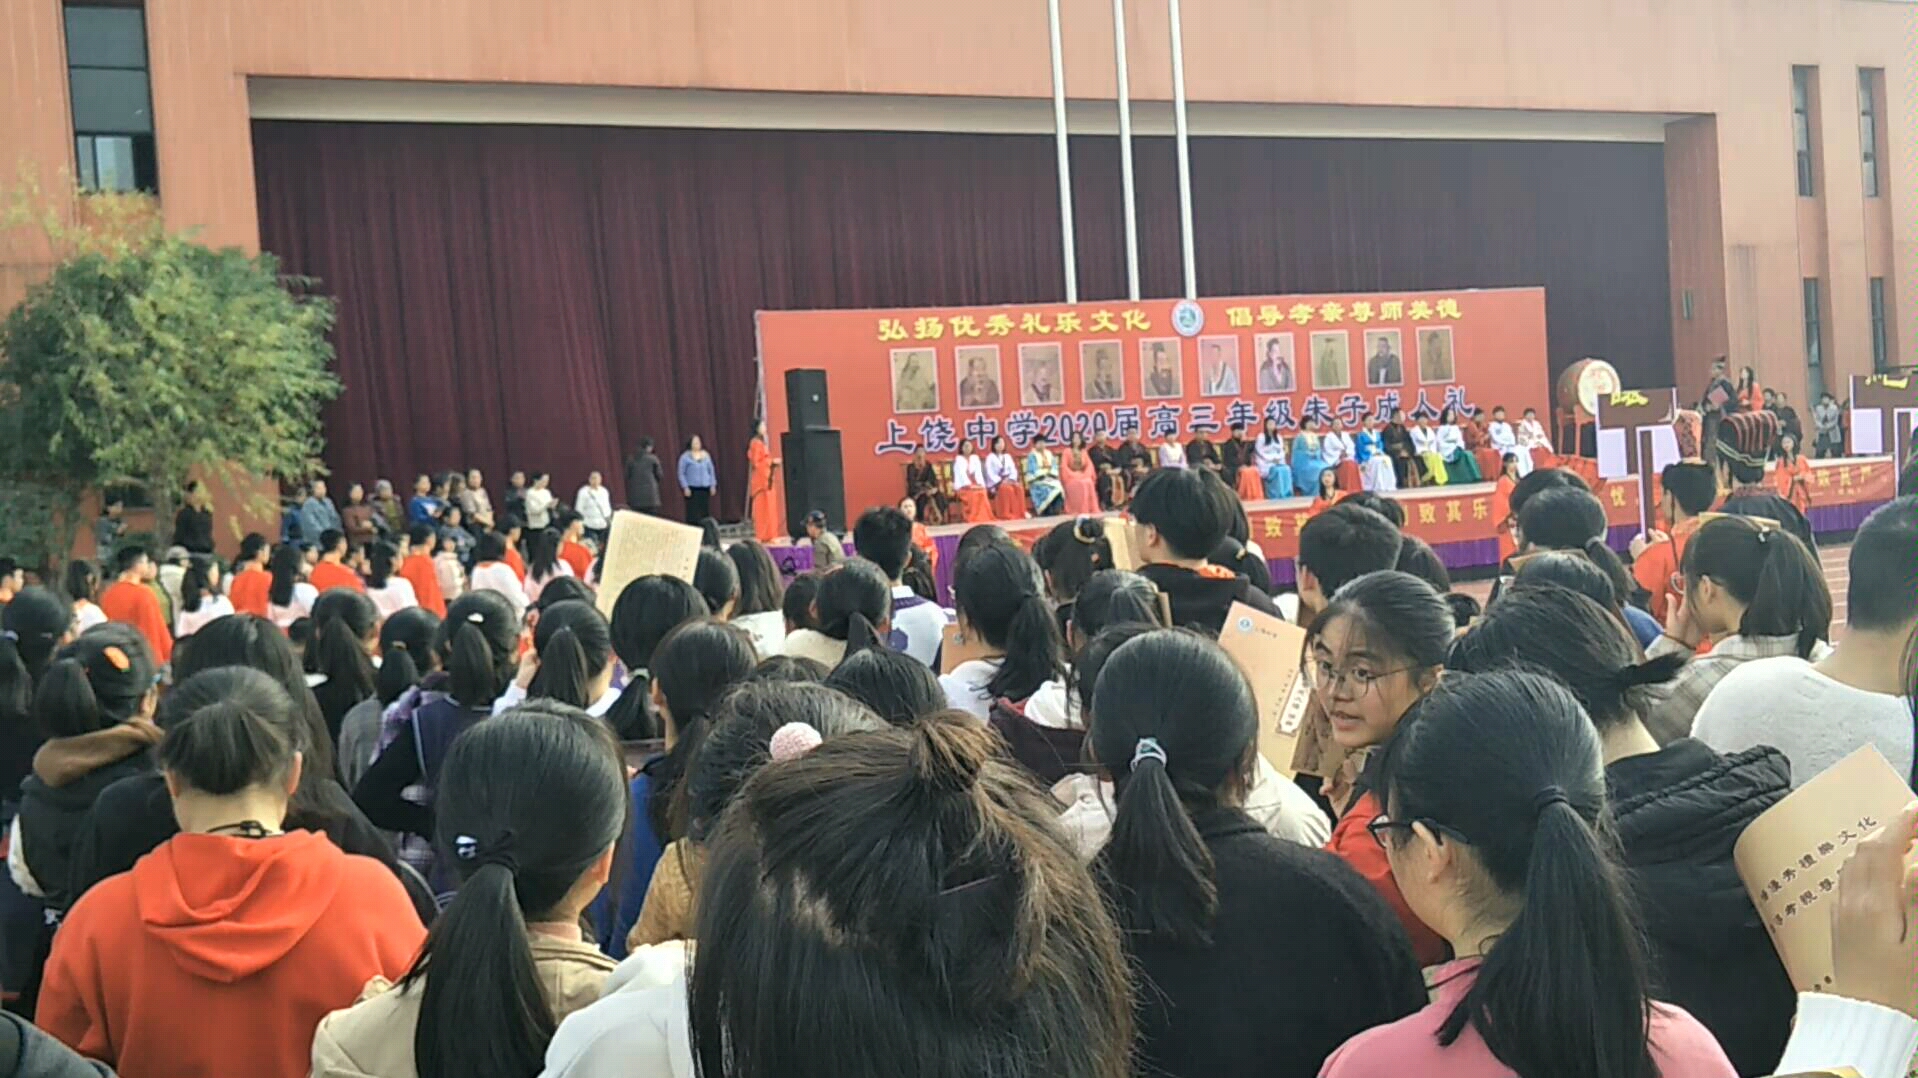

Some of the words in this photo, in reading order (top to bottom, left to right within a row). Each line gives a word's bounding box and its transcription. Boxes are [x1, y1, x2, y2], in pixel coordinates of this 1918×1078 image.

[877, 309, 1151, 342] 弘扬优秀礼乐文化
